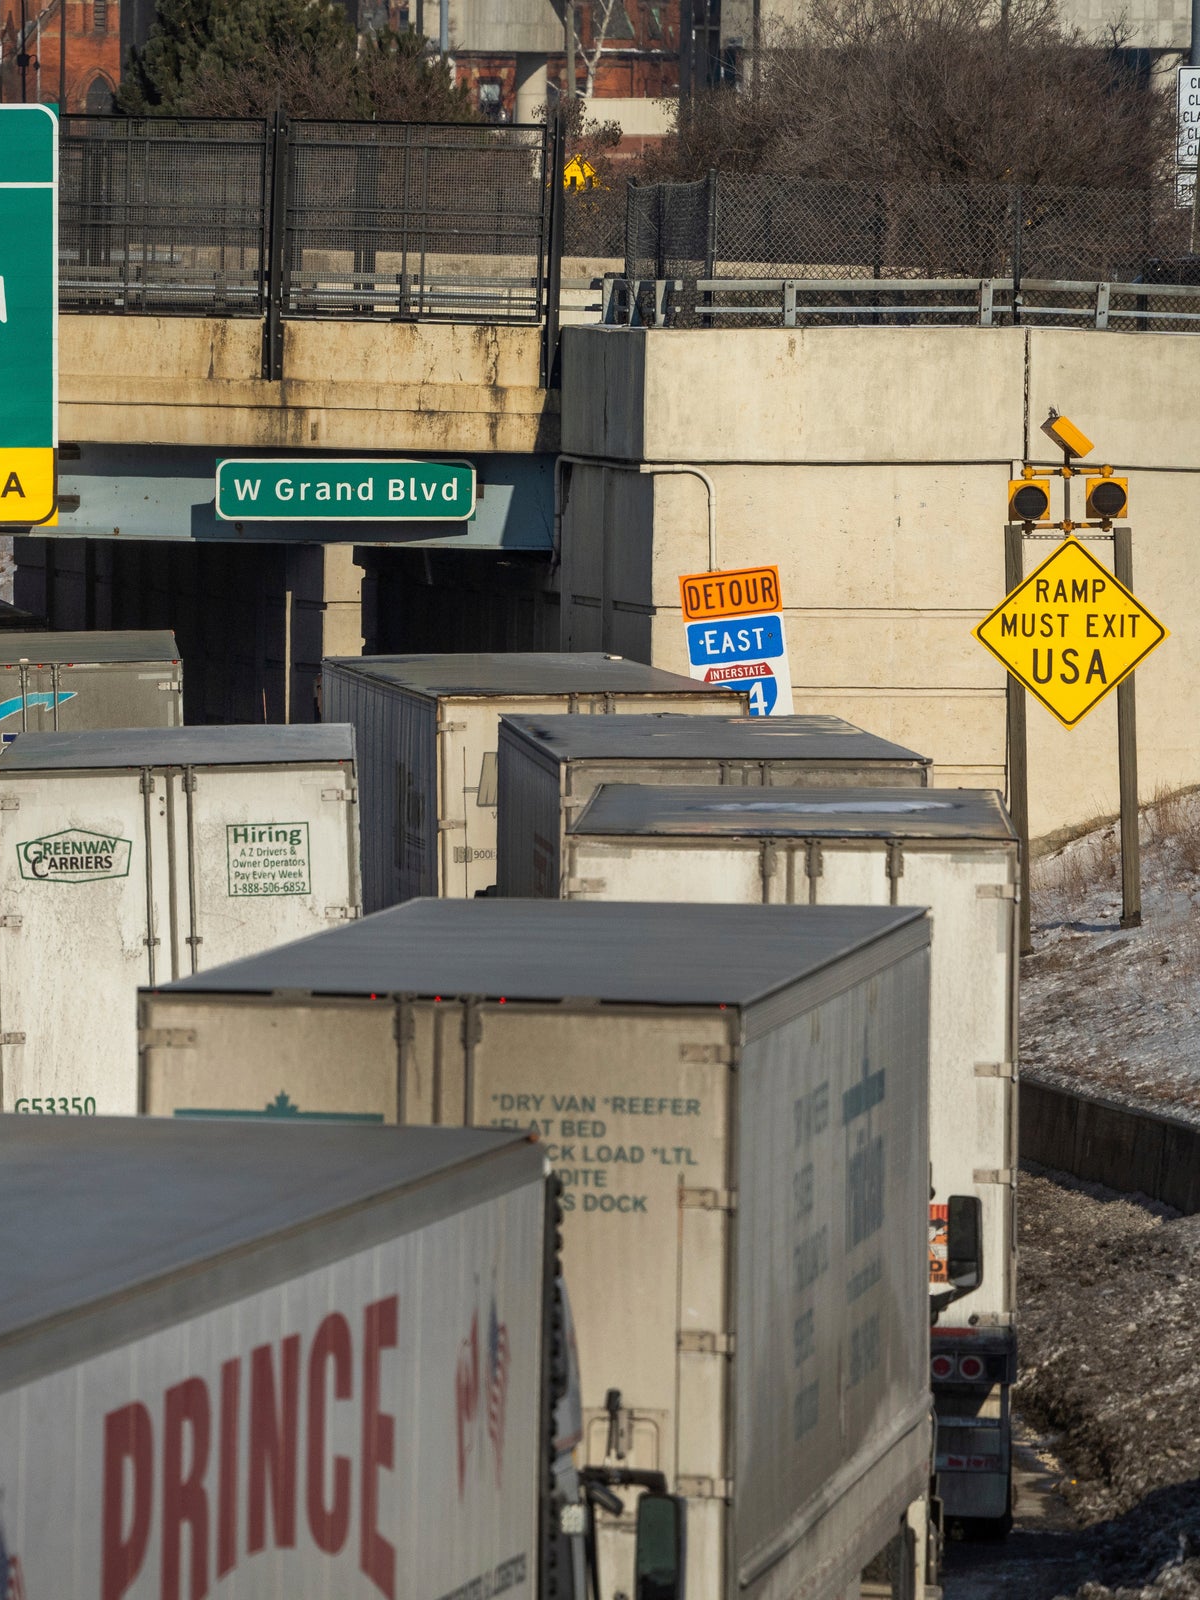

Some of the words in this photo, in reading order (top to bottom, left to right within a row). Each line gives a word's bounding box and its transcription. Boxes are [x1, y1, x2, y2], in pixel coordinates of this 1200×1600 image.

[234, 478, 262, 501] W
[275, 477, 374, 501] Grand
[388, 477, 459, 501] Blvd
[687, 576, 775, 612] DETOUR
[1035, 578, 1106, 603] RAMP
[1001, 613, 1069, 638] MUST
[1086, 613, 1141, 638] EXIT
[704, 627, 765, 655] EAST
[709, 664, 767, 681] INTERSTATE
[1032, 648, 1107, 685] USA
[233, 826, 302, 845] Hiring
[23, 839, 118, 864] GREENWAY
[240, 848, 247, 857] A
[248, 847, 254, 857] Z
[256, 847, 288, 857] Drivers
[290, 845, 297, 855] &
[31, 855, 113, 878] CARRIERS
[232, 859, 261, 868] Owner
[263, 858, 306, 868] Operators
[234, 871, 251, 881] Pay
[253, 870, 276, 880] Every
[278, 869, 304, 879] Week
[233, 881, 306, 894] 1-888-506-6852
[552, 1095, 596, 1113] VAN
[560, 1120, 607, 1138] BED
[582, 1145, 645, 1164] LOAD
[558, 1168, 607, 1188] DITE
[582, 1193, 648, 1213] DOCK
[104, 1293, 398, 1600] PRINCE
